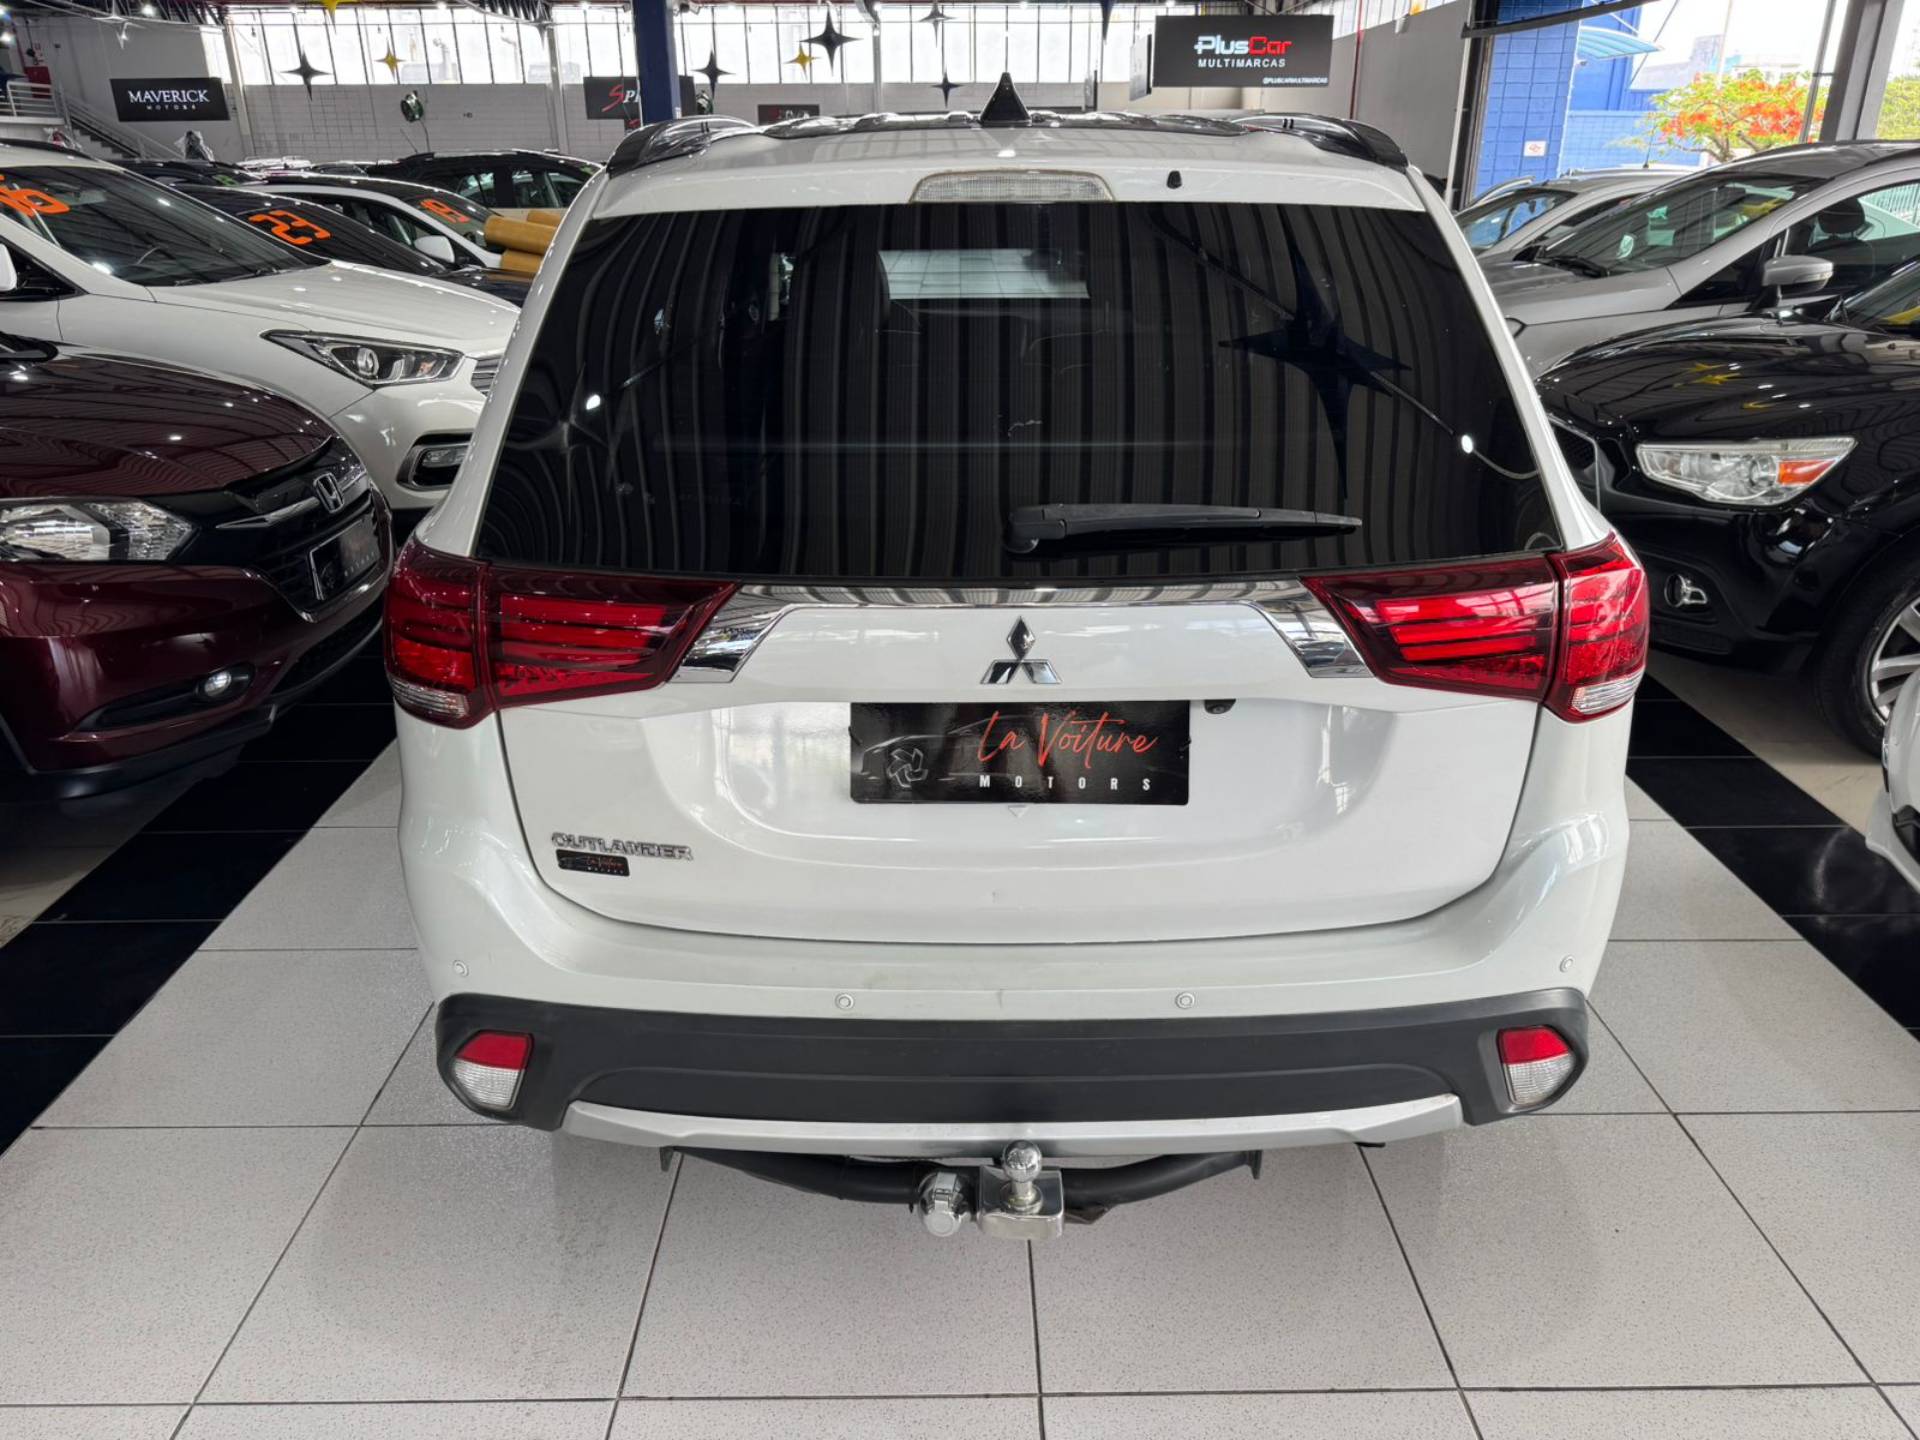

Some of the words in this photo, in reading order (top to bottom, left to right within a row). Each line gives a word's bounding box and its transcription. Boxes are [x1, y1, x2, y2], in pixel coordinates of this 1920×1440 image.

[1194, 35, 1292, 55] PlusCar
[1198, 58, 1286, 67] MULTIMARCAS
[128, 90, 210, 103] MAVERICK
[978, 711, 1025, 763] La
[1037, 711, 1159, 768] Voiture
[979, 775, 1151, 791] MOTORS
[551, 832, 694, 861] OUTLANDER
